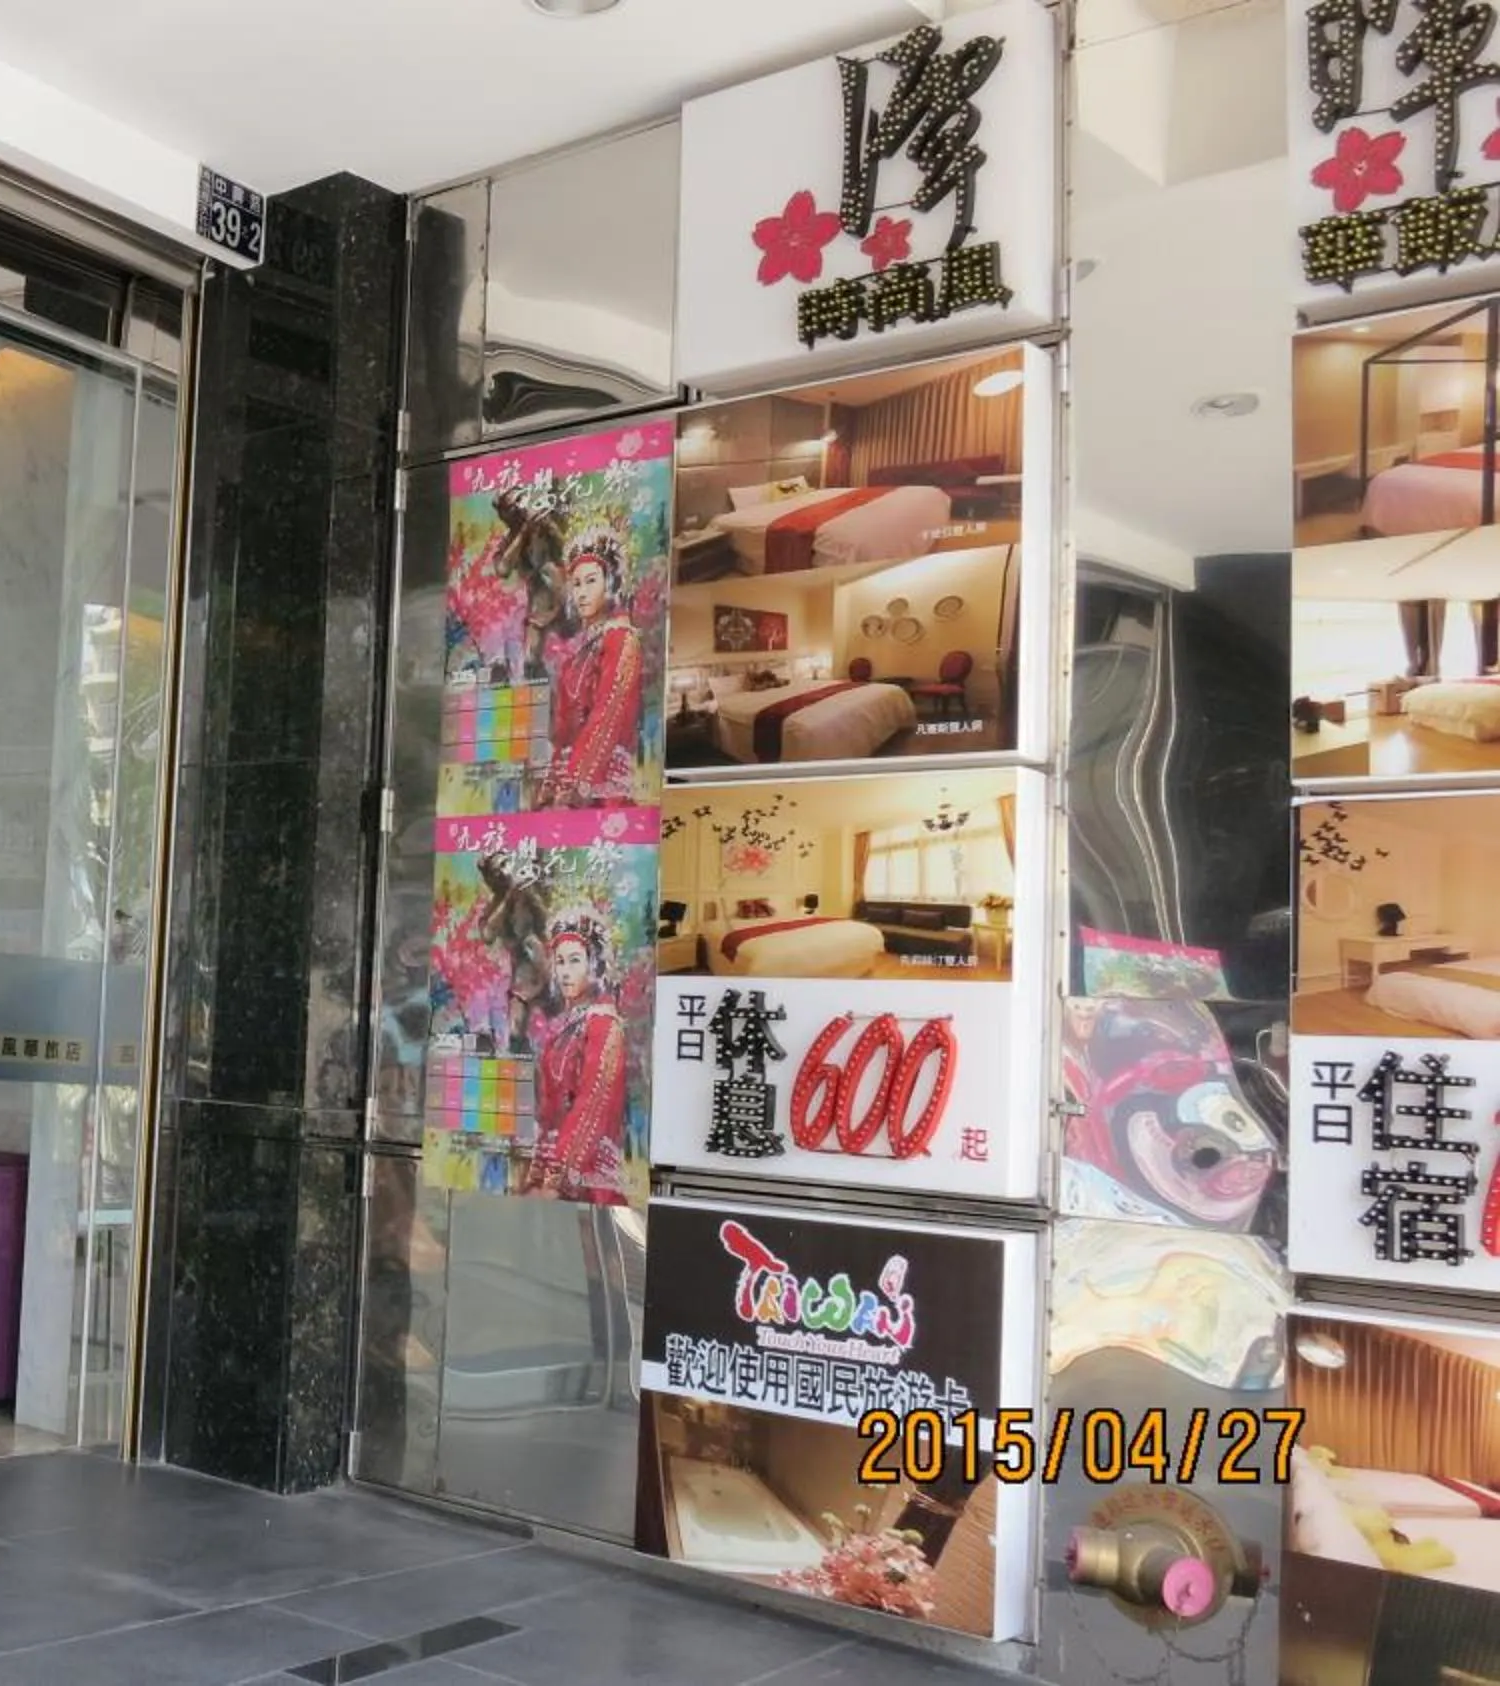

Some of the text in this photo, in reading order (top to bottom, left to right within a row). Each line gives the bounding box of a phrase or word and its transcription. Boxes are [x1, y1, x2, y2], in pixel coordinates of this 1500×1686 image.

[676, 989, 990, 1162] 平日 休息 600 起
[1311, 1061, 1355, 1145] 平日
[1357, 1050, 1480, 1266] 住宿
